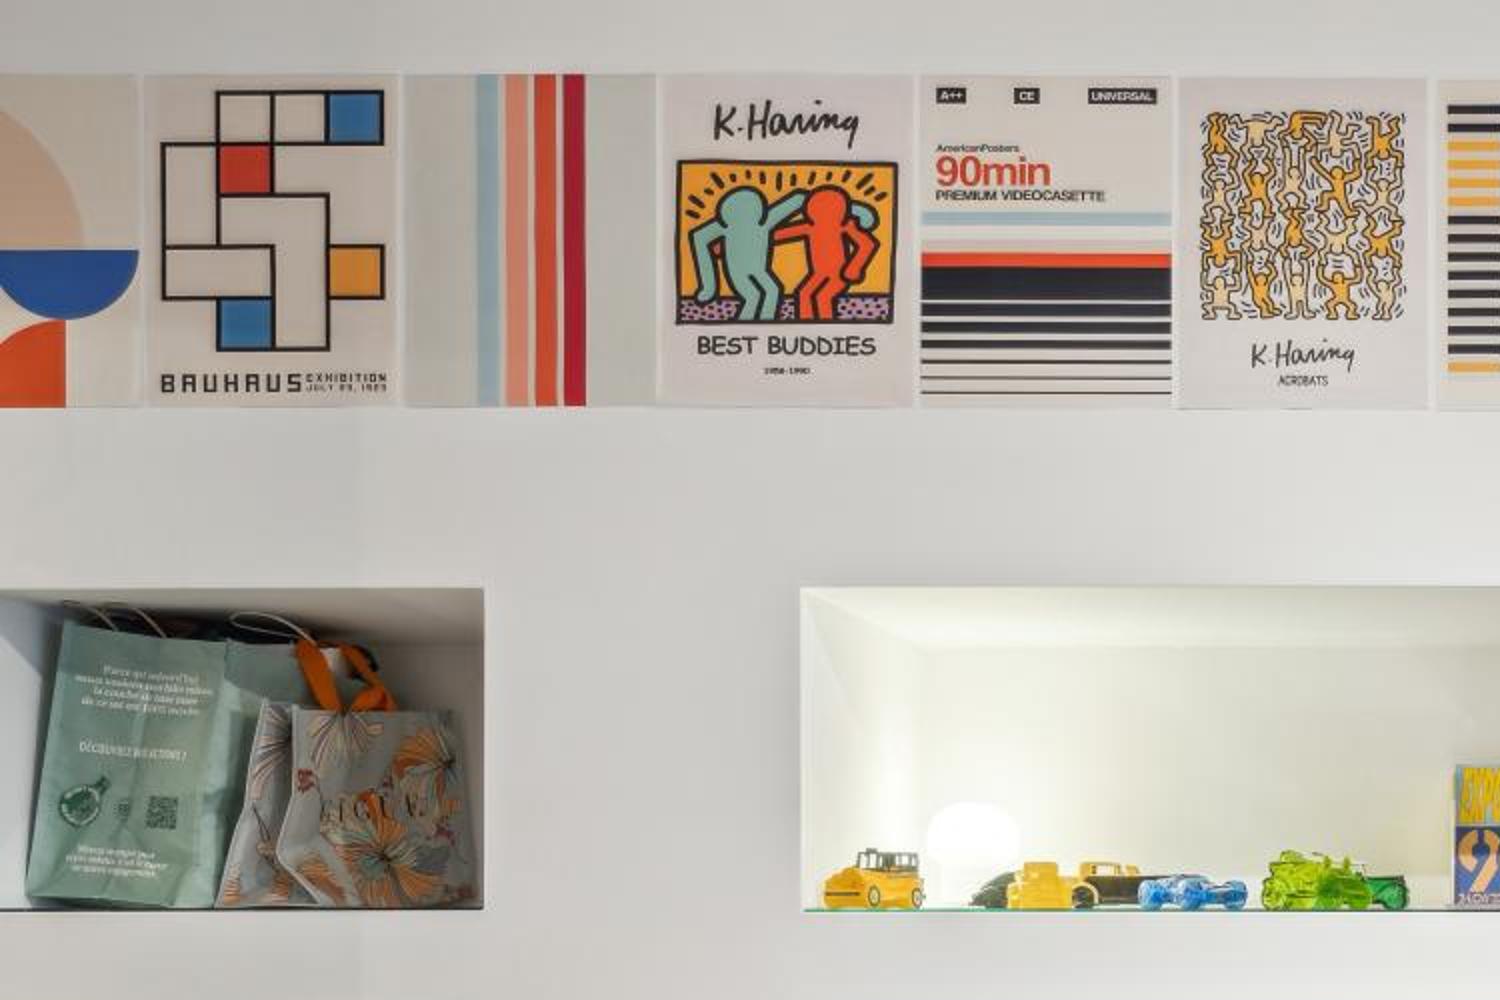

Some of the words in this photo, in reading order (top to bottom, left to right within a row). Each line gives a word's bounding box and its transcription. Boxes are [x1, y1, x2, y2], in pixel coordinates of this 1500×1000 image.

[938, 90, 964, 101] A++
[1018, 90, 1036, 102] CE
[1090, 90, 1154, 102] UNIVERSAL
[936, 144, 1020, 153] AmericanPosters
[936, 154, 1052, 188] 90min
[936, 190, 997, 201] PREMIUM
[1001, 190, 1106, 201] VIDEOCASETTE
[697, 336, 758, 355] BEST
[767, 336, 877, 356] BUDDIES
[161, 373, 302, 393] BAUHAUS
[305, 373, 387, 383] EXHIBITION
[1278, 375, 1329, 386] ACROBATS
